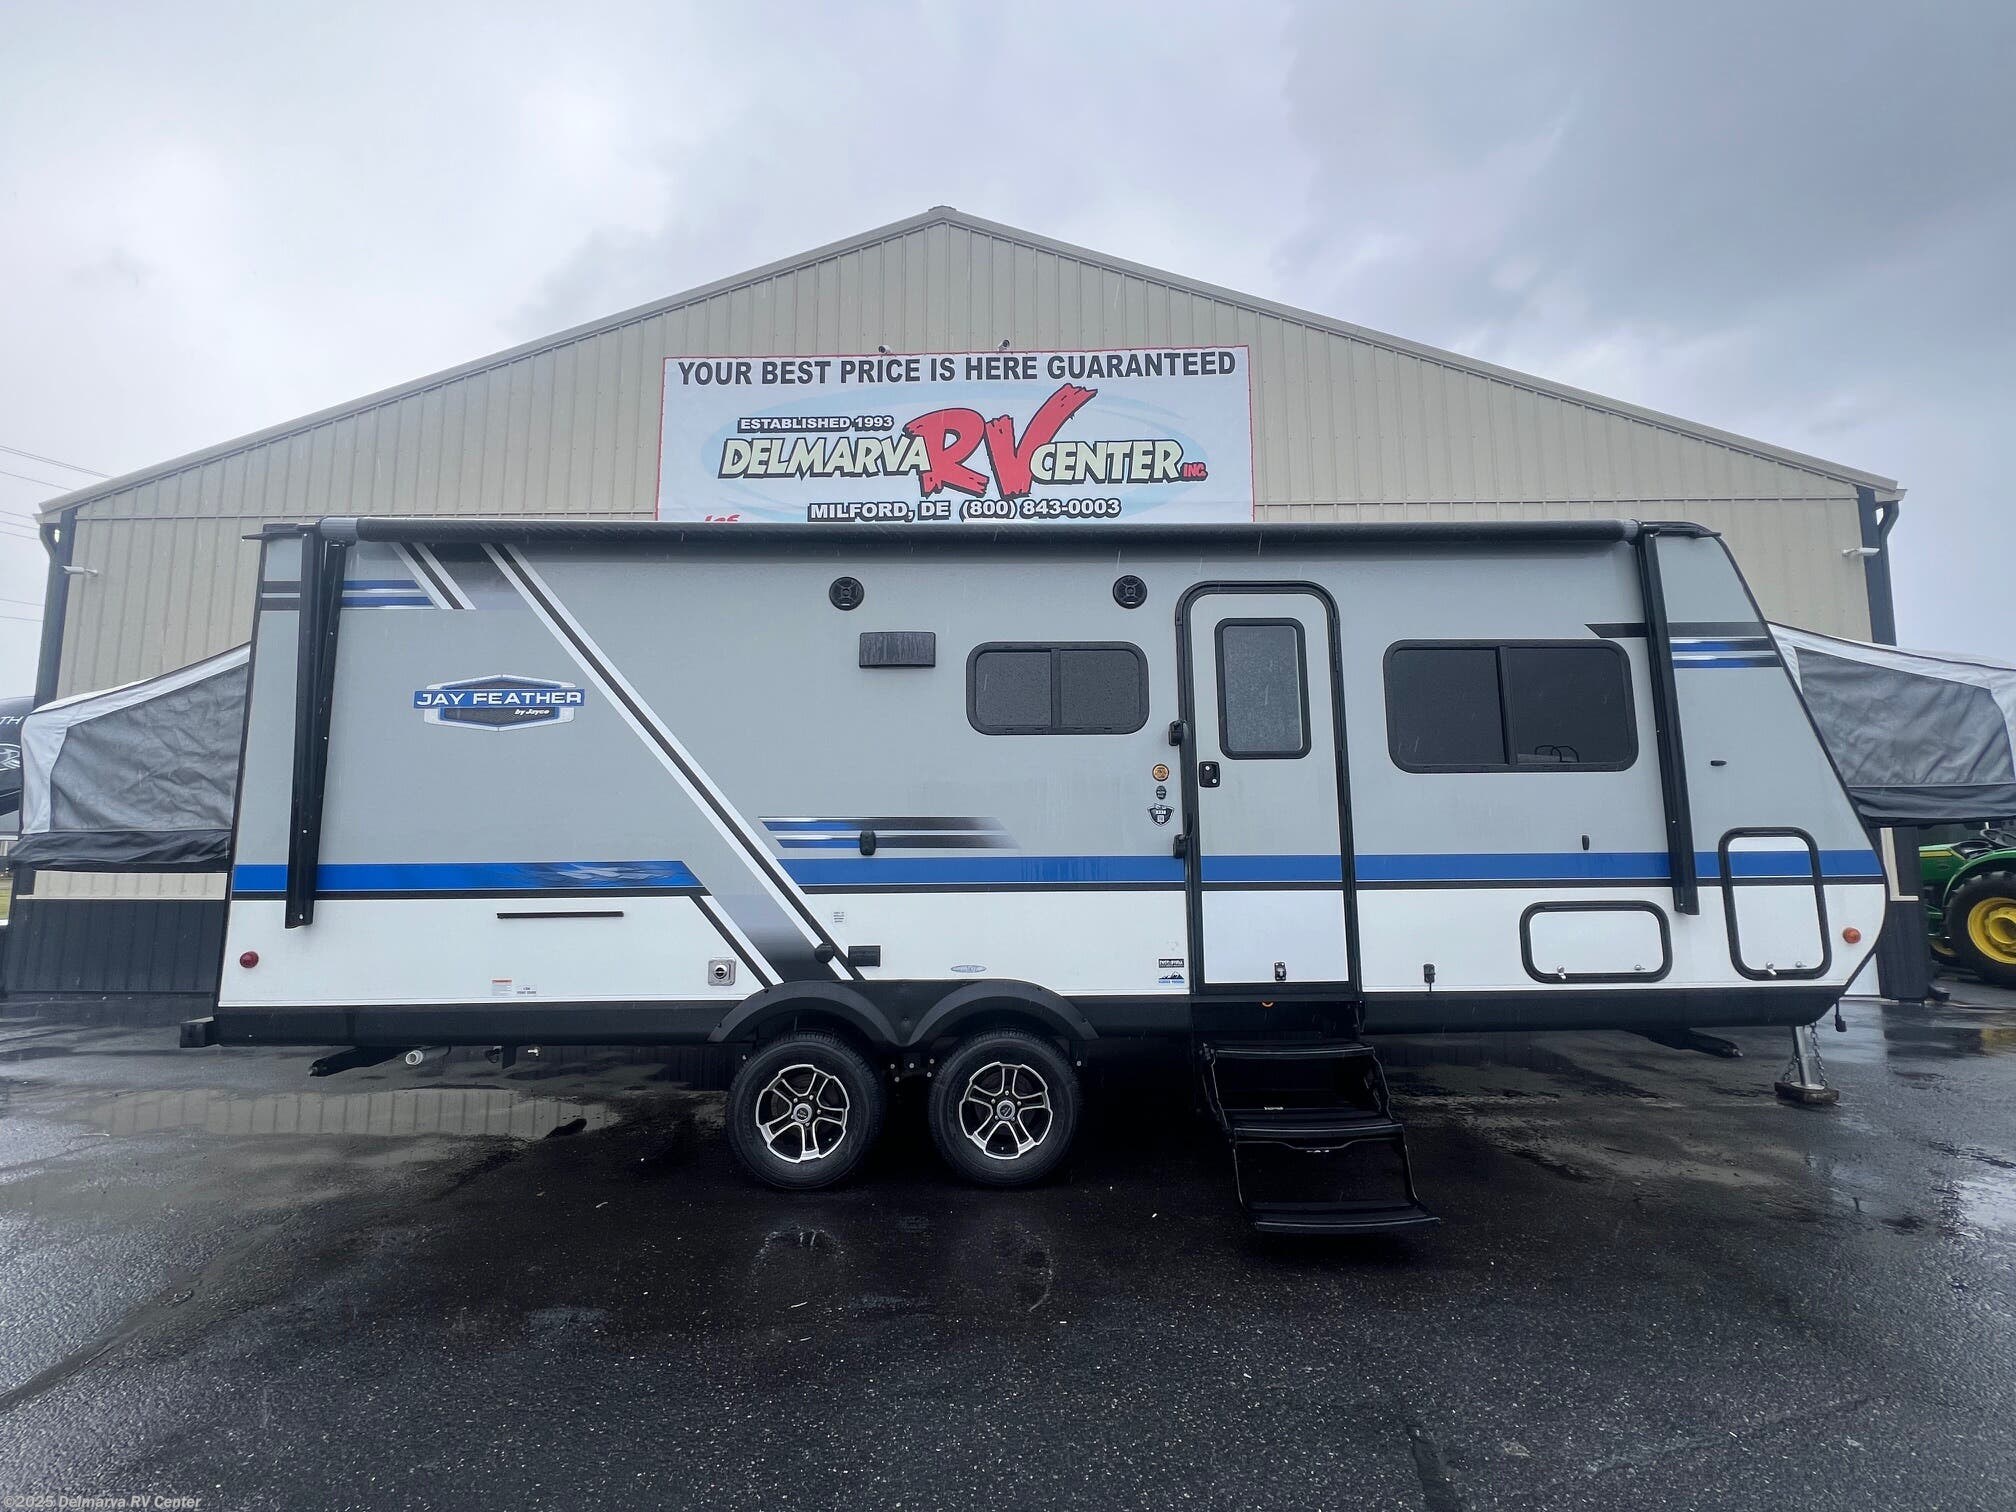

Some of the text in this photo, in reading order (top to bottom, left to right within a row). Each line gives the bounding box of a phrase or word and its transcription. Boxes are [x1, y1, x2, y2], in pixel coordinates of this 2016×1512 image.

[678, 351, 1236, 385] YOUR BEST PRICE IS HERE GUARANTEED
[739, 415, 893, 431] ESTABLISHED 1993
[719, 435, 932, 478] DELMARVA
[903, 383, 1098, 498] RV
[1030, 440, 1184, 483] CENTER
[810, 499, 1121, 520] MILFORD, DE (800) 843-0003
[416, 691, 582, 706] JAY FEATHER
[525, 708, 551, 716] Jayco
